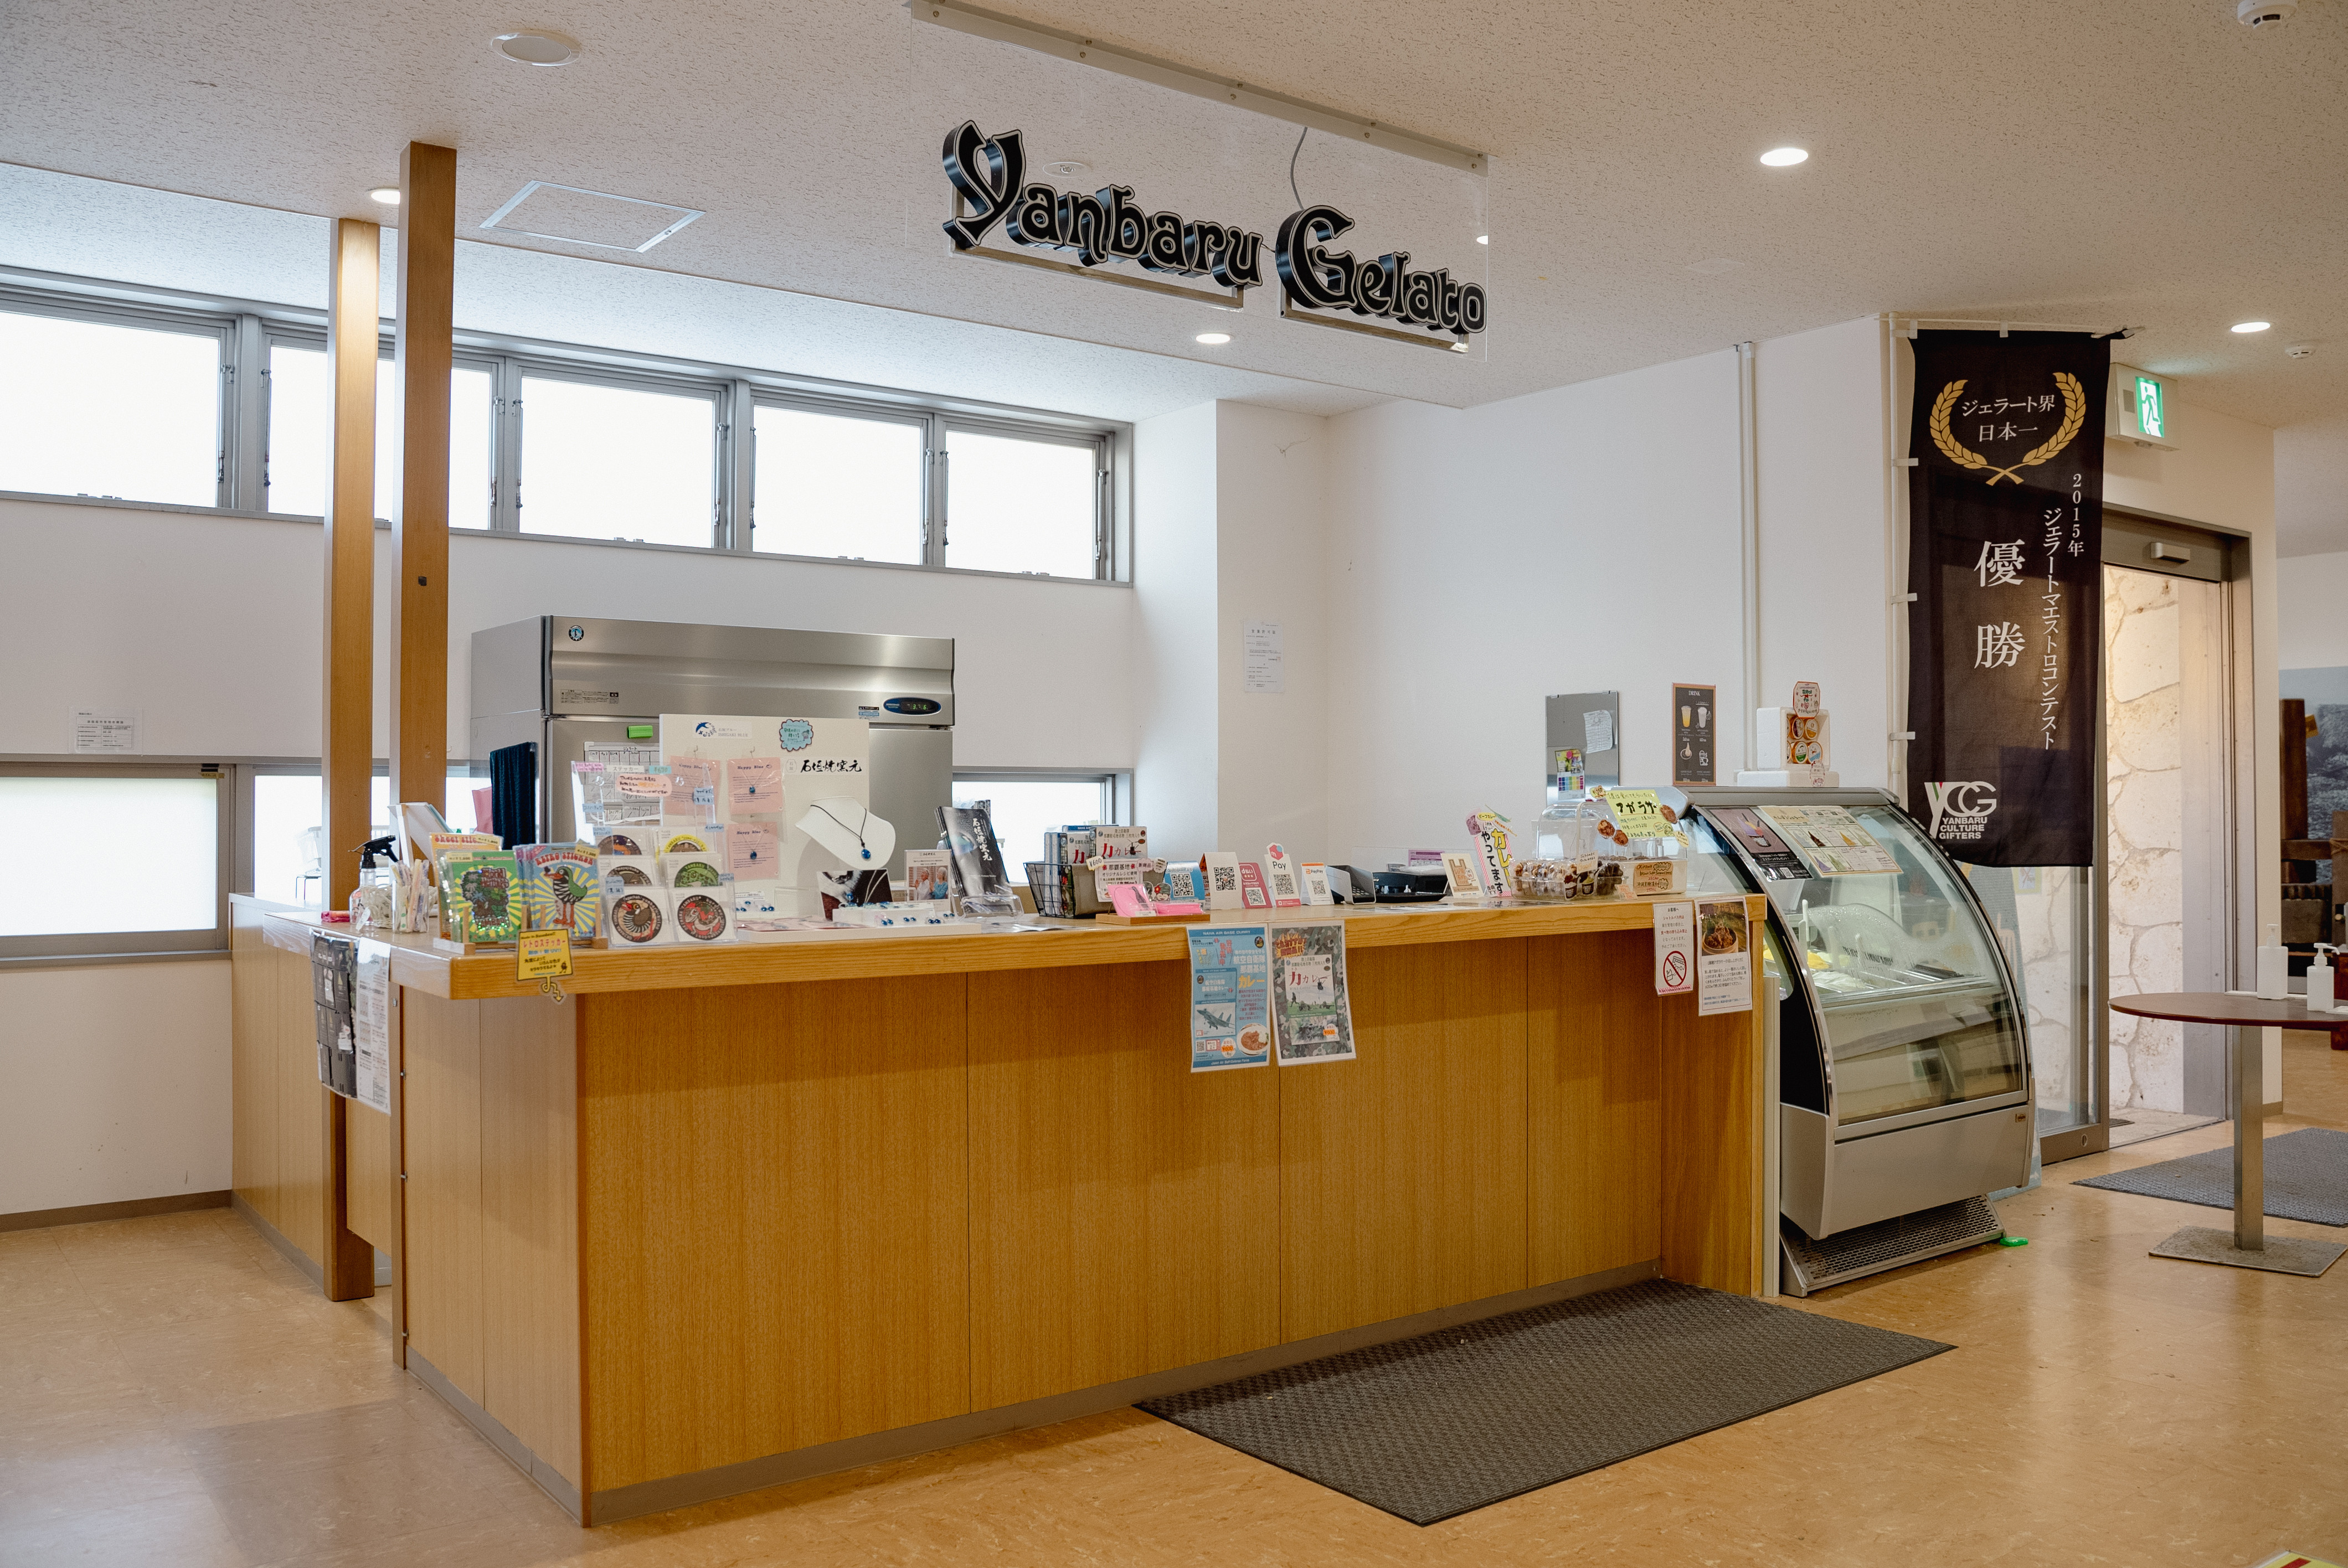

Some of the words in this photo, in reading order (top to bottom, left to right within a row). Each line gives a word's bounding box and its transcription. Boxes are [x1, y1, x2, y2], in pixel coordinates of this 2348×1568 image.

[942, 120, 1263, 288] Yanbaru
[1275, 205, 1487, 335] Gelato
[1961, 394, 2055, 416] ジェラート界
[1979, 421, 2038, 442] 日本一
[2067, 473, 2084, 557] 2015年
[1973, 538, 2026, 669] 優勝
[2040, 508, 2063, 750] ジェラートマエストロコンテスト
[1089, 858, 1102, 868] ¥600
[1273, 862, 1286, 870] Pay
[1481, 831, 1503, 894] やってます
[1491, 828, 1512, 888] カレー
[1233, 955, 1266, 964] 航空自衛隊
[1240, 964, 1266, 973] 那覇基地
[1238, 975, 1265, 988] カレー
[1289, 971, 1327, 986] 力カレー
